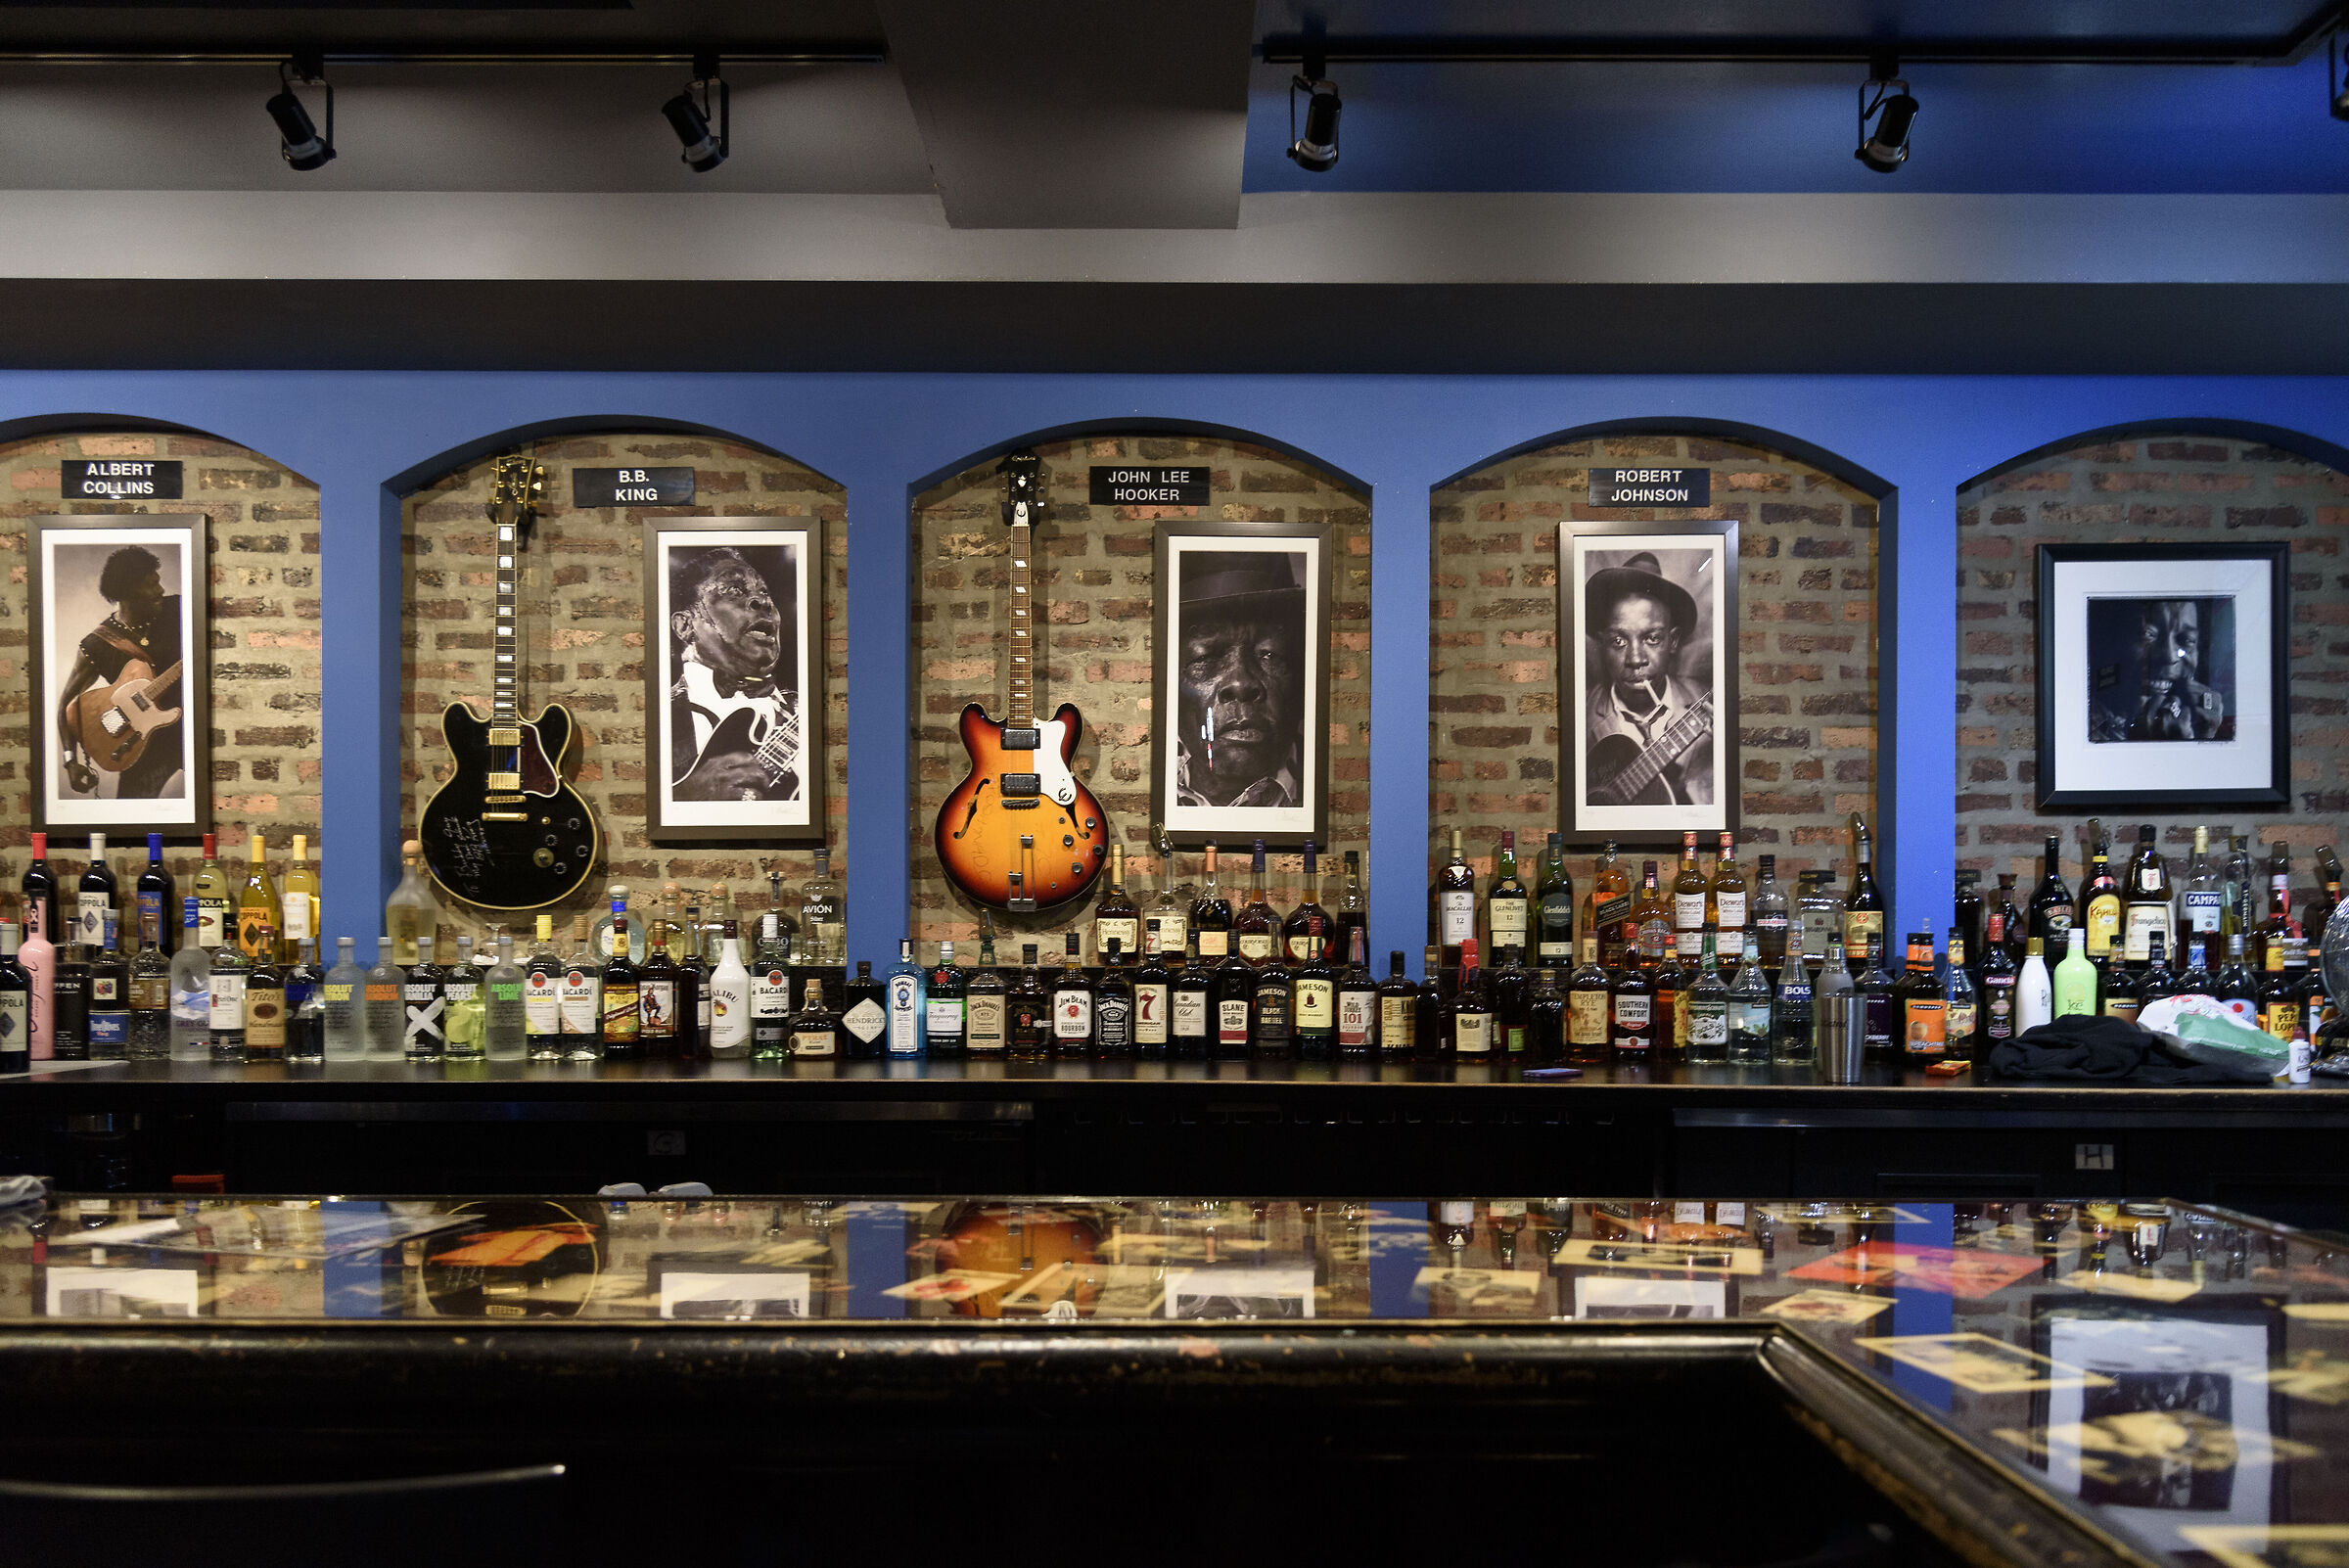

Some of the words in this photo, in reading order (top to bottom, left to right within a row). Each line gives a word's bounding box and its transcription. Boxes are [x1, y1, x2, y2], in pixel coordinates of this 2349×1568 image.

[87, 463, 155, 477] ALBERT
[1615, 469, 1682, 483] ROBERT
[619, 470, 650, 484] B.B.
[1108, 471, 1151, 484] JOHN
[1161, 471, 1190, 484] LEE
[83, 481, 155, 495] COLLINS
[615, 487, 658, 501] KING
[1114, 488, 1180, 501] HOOKER
[1611, 488, 1688, 502] JOHNSON
[803, 902, 833, 914] AVIÓN
[1495, 904, 1525, 913] GLENLIVET
[252, 992, 282, 1002] Tito's
[527, 987, 556, 996] ACARDÍ
[713, 989, 741, 1003] ALIBU
[759, 987, 788, 995] BACARD
[1256, 988, 1288, 997] JAMESON
[1784, 986, 1811, 995] BOLS
[1059, 998, 1071, 1008] JIM
[1071, 995, 1088, 1007] BEAM
[1138, 993, 1157, 1021] 7
[1618, 1000, 1648, 1009] SOUTHERN
[1343, 1012, 1363, 1024] 101
[1620, 1009, 1648, 1018] COMFORT
[2083, 1144, 2103, 1167] H
